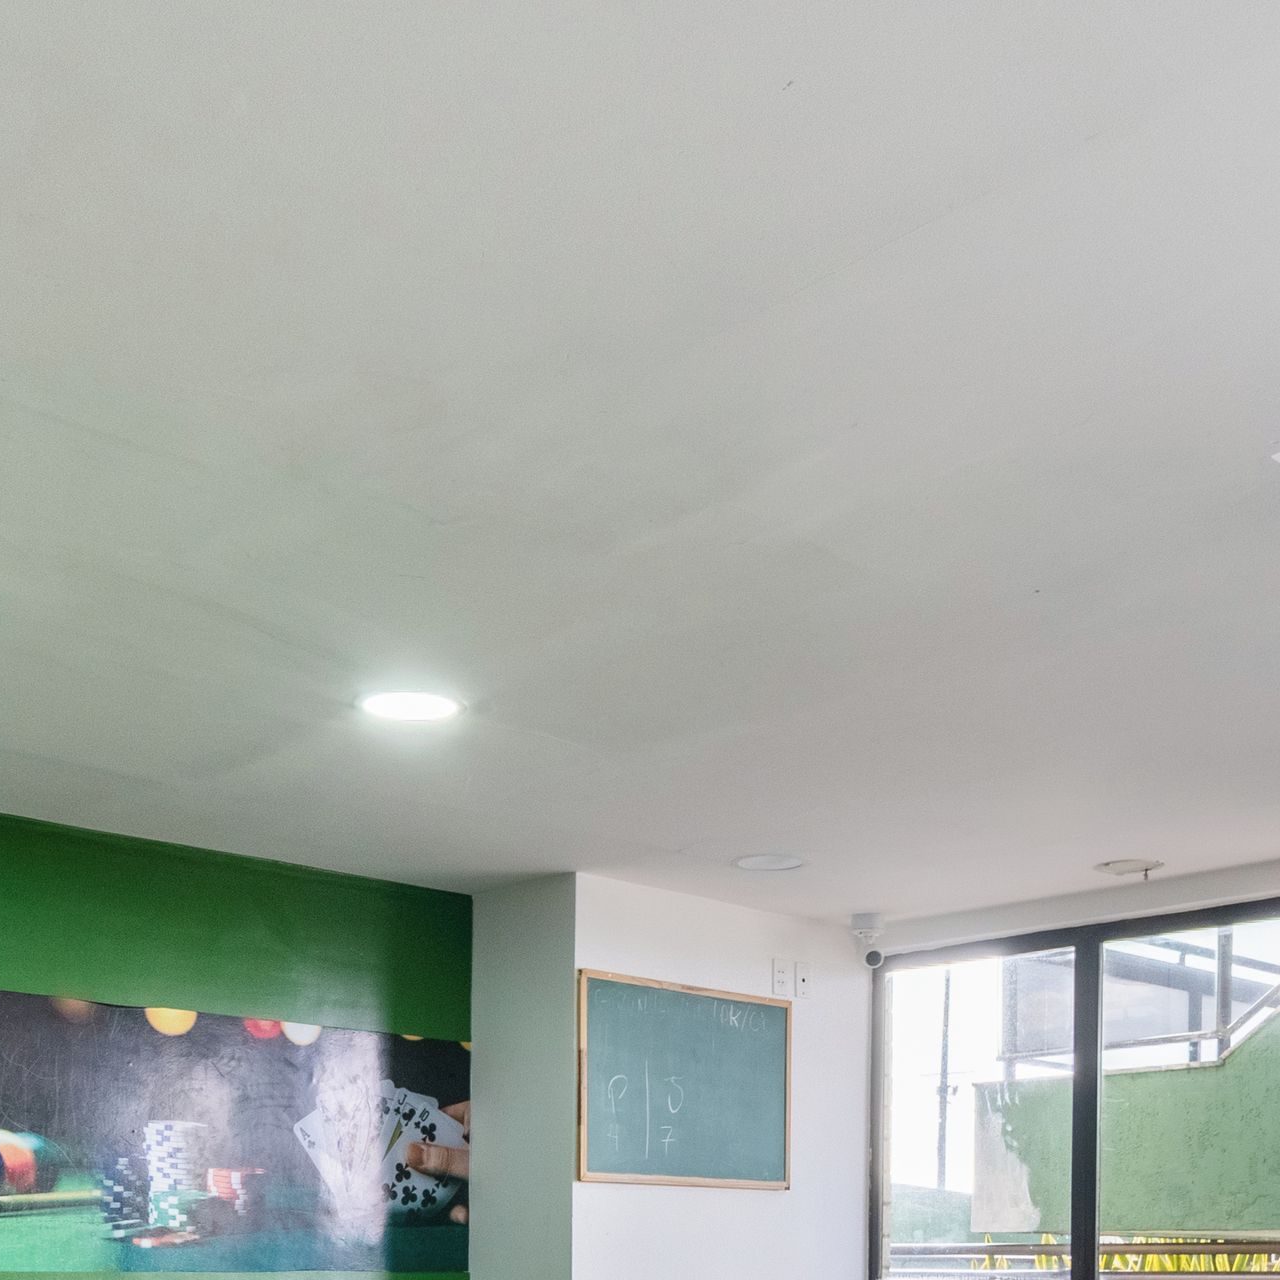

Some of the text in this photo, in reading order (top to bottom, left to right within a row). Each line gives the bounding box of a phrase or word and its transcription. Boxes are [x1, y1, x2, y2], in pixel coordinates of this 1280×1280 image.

[397, 1094, 407, 1106] J
[417, 1107, 432, 1122] 10
[299, 1127, 311, 1141] A
[660, 1125, 677, 1155] 7
